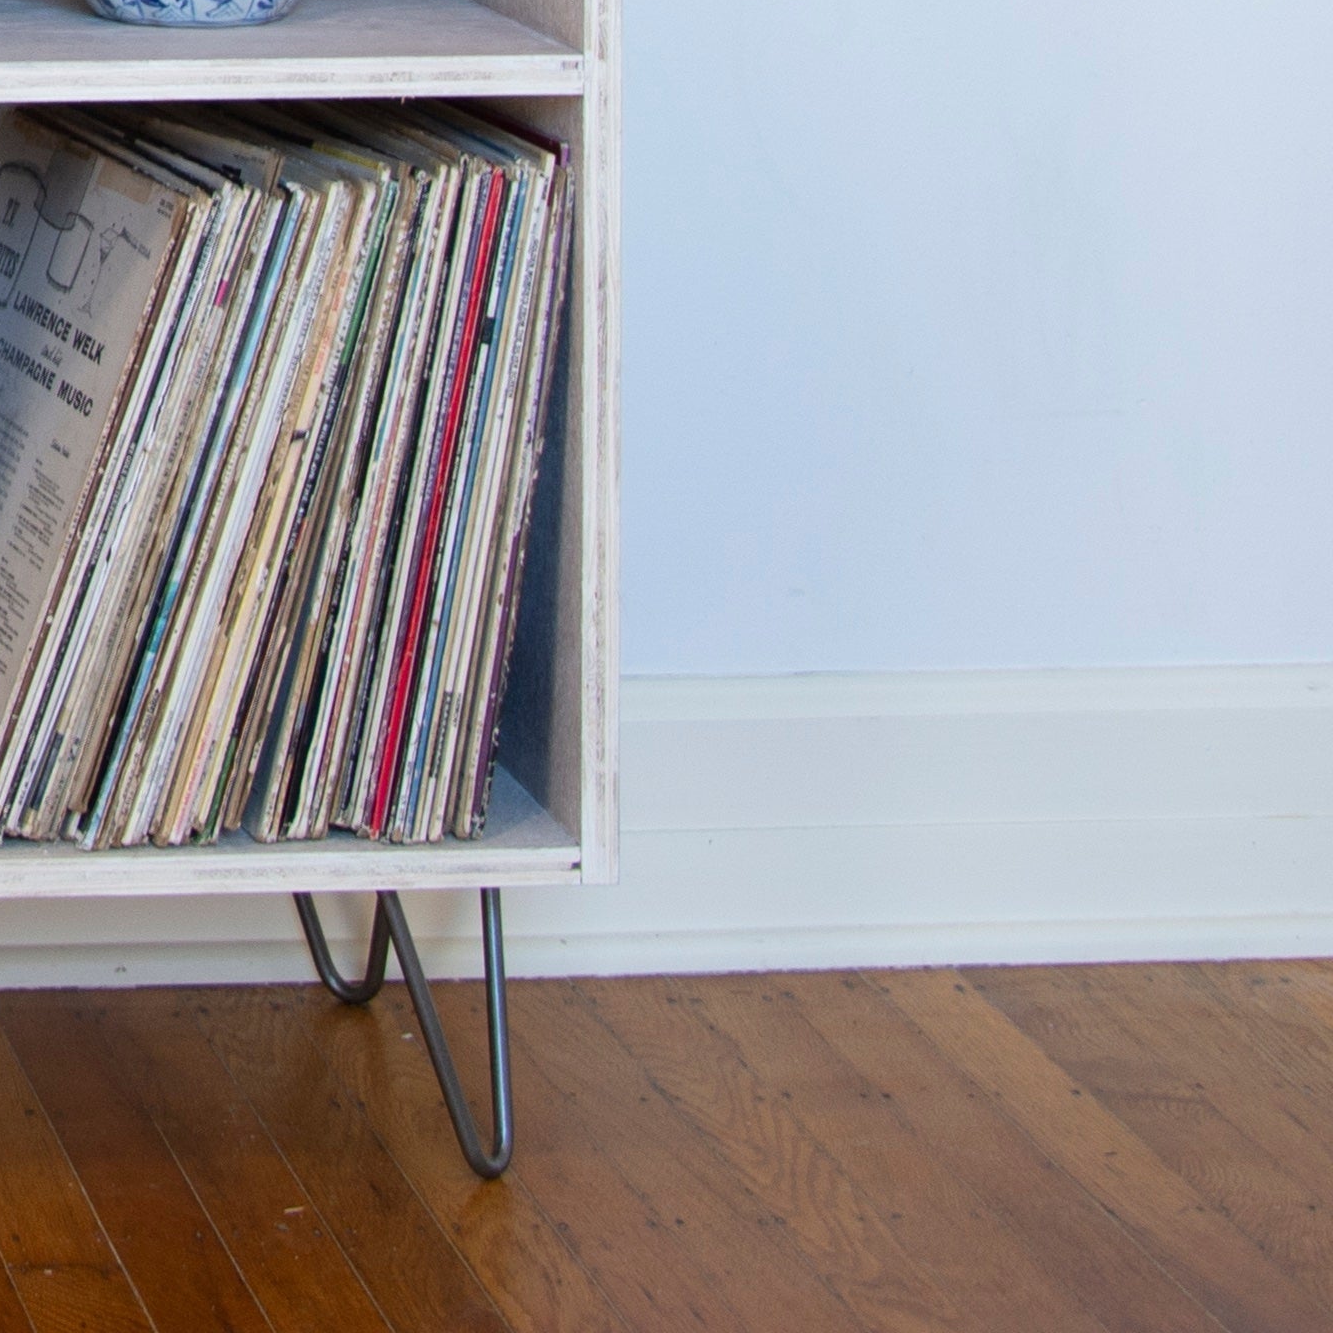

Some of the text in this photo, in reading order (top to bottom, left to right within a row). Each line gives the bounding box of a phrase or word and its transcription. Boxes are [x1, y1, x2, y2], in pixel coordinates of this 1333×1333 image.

[13, 290, 106, 365] LAWRENCE WELK
[452, 320, 462, 341] ARE
[507, 239, 539, 398] GOLDEN MOMENTS FROM THE SILVER SCREEN
[448, 346, 457, 364] BUT
[57, 379, 94, 417] MUSIC
[324, 385, 339, 420] GLENN
[439, 377, 452, 414] DREAM
[167, 431, 182, 463] PLAYED
[313, 423, 328, 460] MILLER
[424, 432, 442, 501] MARIO LANZA
[301, 483, 311, 501] THE
